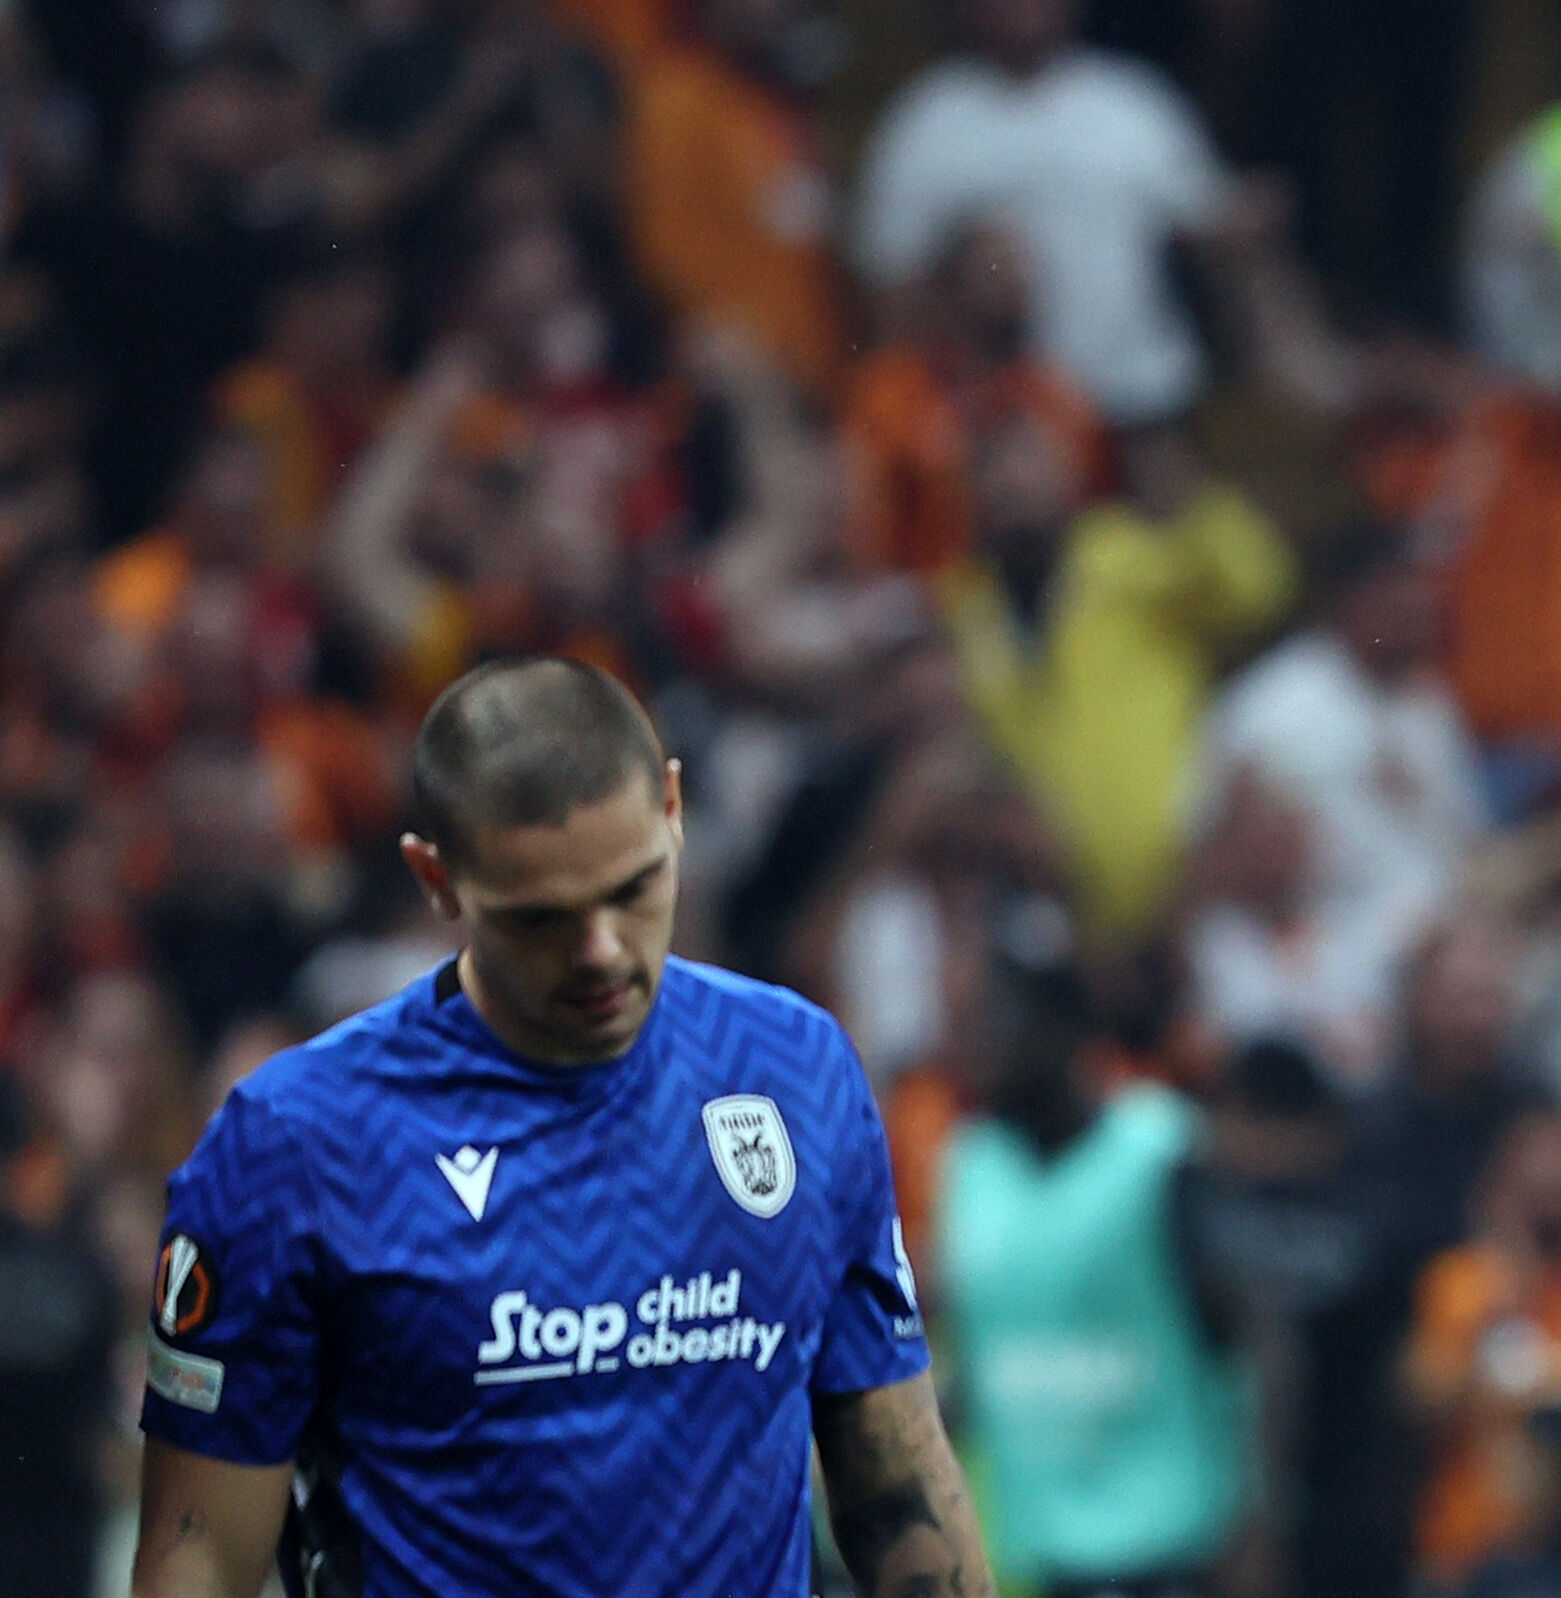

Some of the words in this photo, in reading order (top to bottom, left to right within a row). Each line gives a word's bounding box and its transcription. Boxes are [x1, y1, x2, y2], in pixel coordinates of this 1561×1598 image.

[478, 1289, 628, 1375] Stop
[636, 1268, 741, 1325] child
[626, 1317, 786, 1373] obesity
